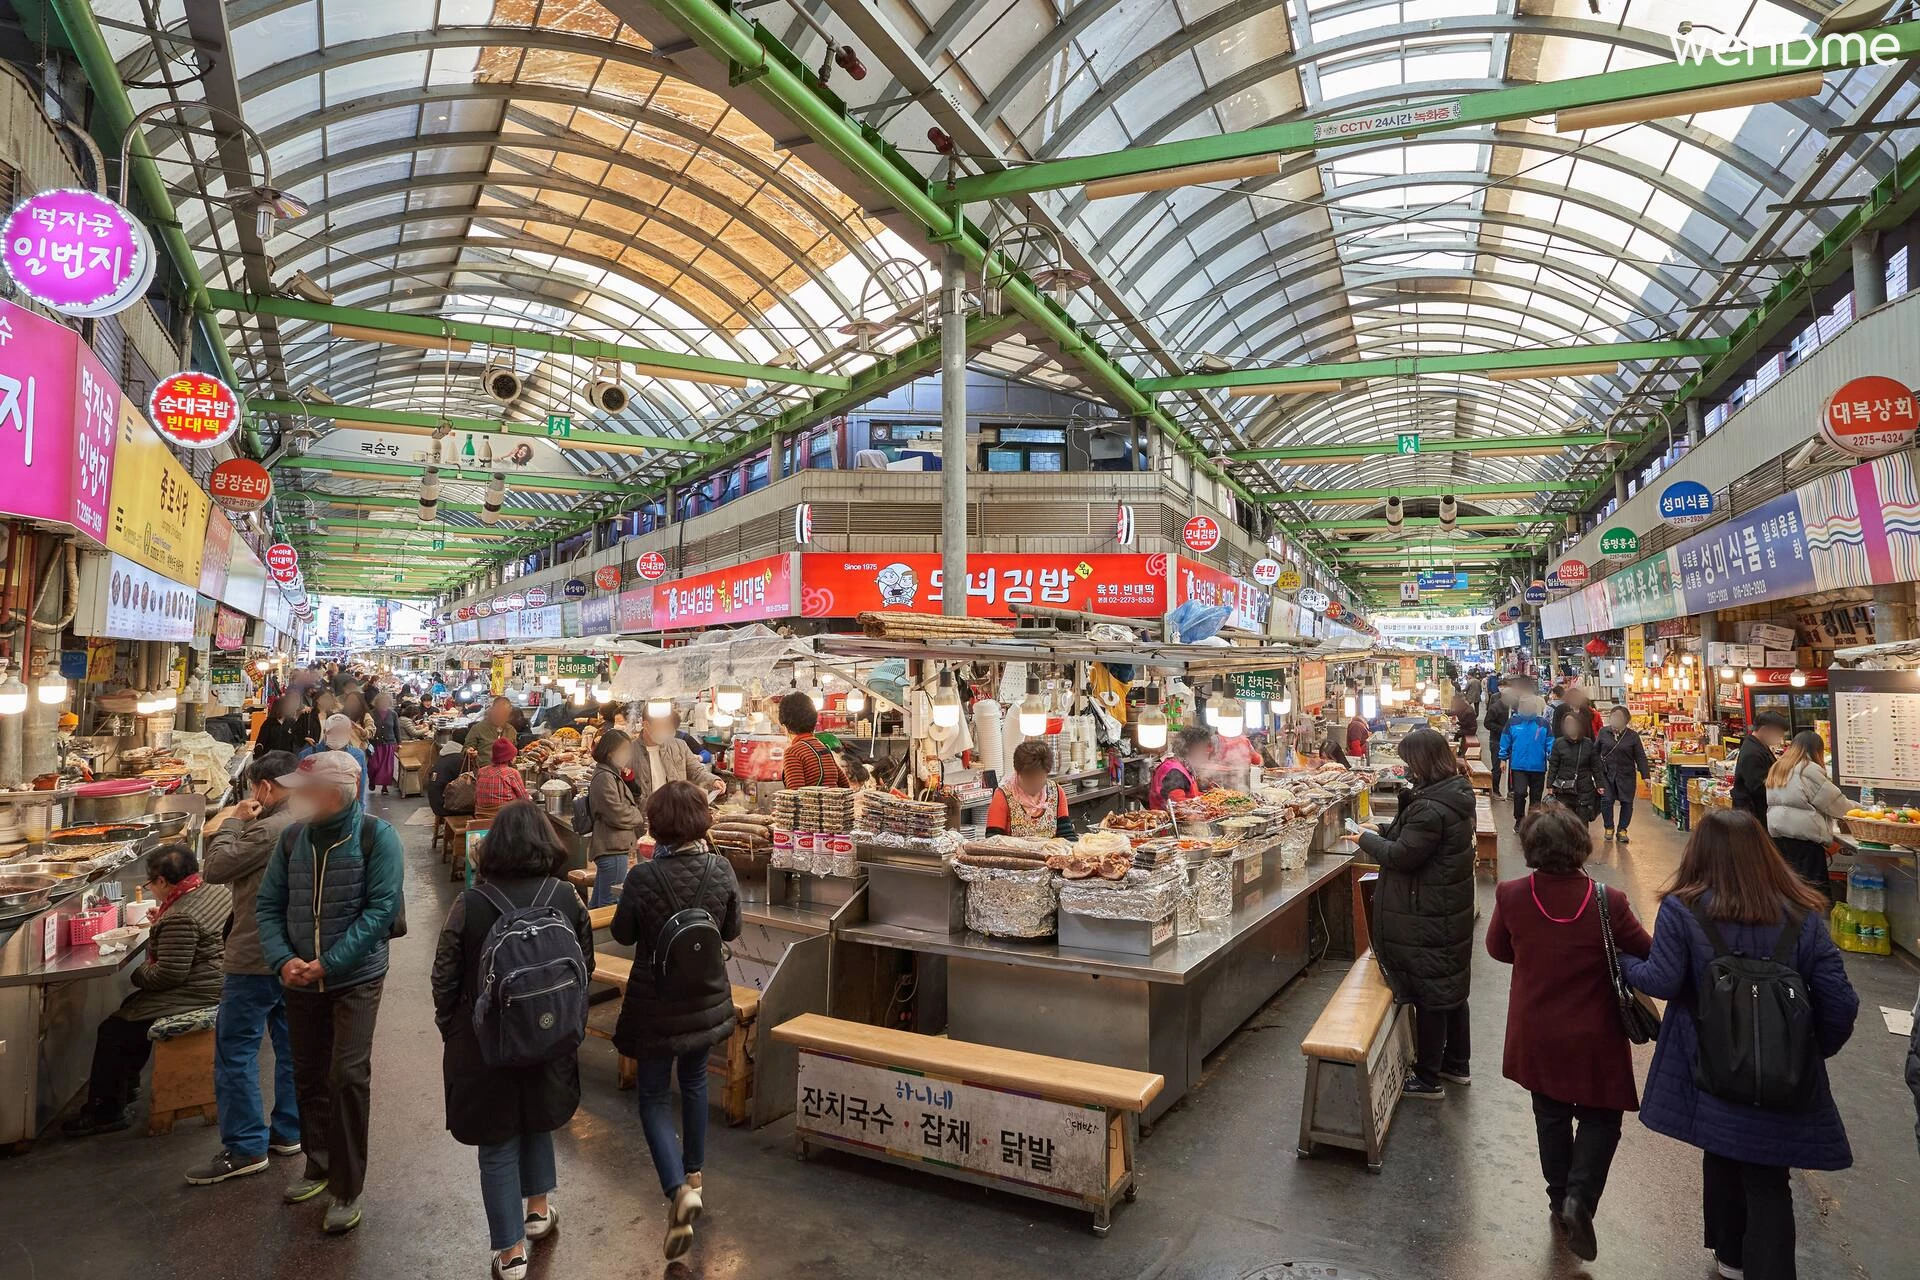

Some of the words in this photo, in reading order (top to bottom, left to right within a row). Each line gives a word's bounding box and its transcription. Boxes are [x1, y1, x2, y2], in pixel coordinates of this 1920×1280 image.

[1340, 120, 1373, 133] CCTV
[1375, 113, 1412, 128] 24시간
[1414, 107, 1450, 122] 녹화중
[32, 207, 114, 238] 먹자골
[14, 237, 123, 285] 일번지
[172, 380, 218, 398] 육회
[82, 365, 113, 447] 먹자골
[159, 395, 231, 419] 순대국밥
[1832, 396, 1914, 425] 대복상회
[166, 416, 221, 434] 빈대떡
[361, 440, 400, 457] 국순당
[1852, 432, 1904, 447] 2275-4324
[78, 432, 110, 506] 일번지
[214, 472, 268, 495] 광장순대
[1662, 493, 1711, 513] 성미식품
[1602, 537, 1637, 550] 동명홍삼
[1700, 525, 1762, 585] 성미식품
[680, 584, 715, 616] 모녀김밥
[734, 575, 766, 610] 빈대떡
[1235, 688, 1281, 700] 2268-6738
[1247, 675, 1282, 691] 잔치국수
[896, 1080, 953, 1110] 하니네
[802, 1086, 895, 1135] 잔치국수
[920, 1112, 970, 1154] 잡채
[1000, 1130, 1055, 1172] 닭발
